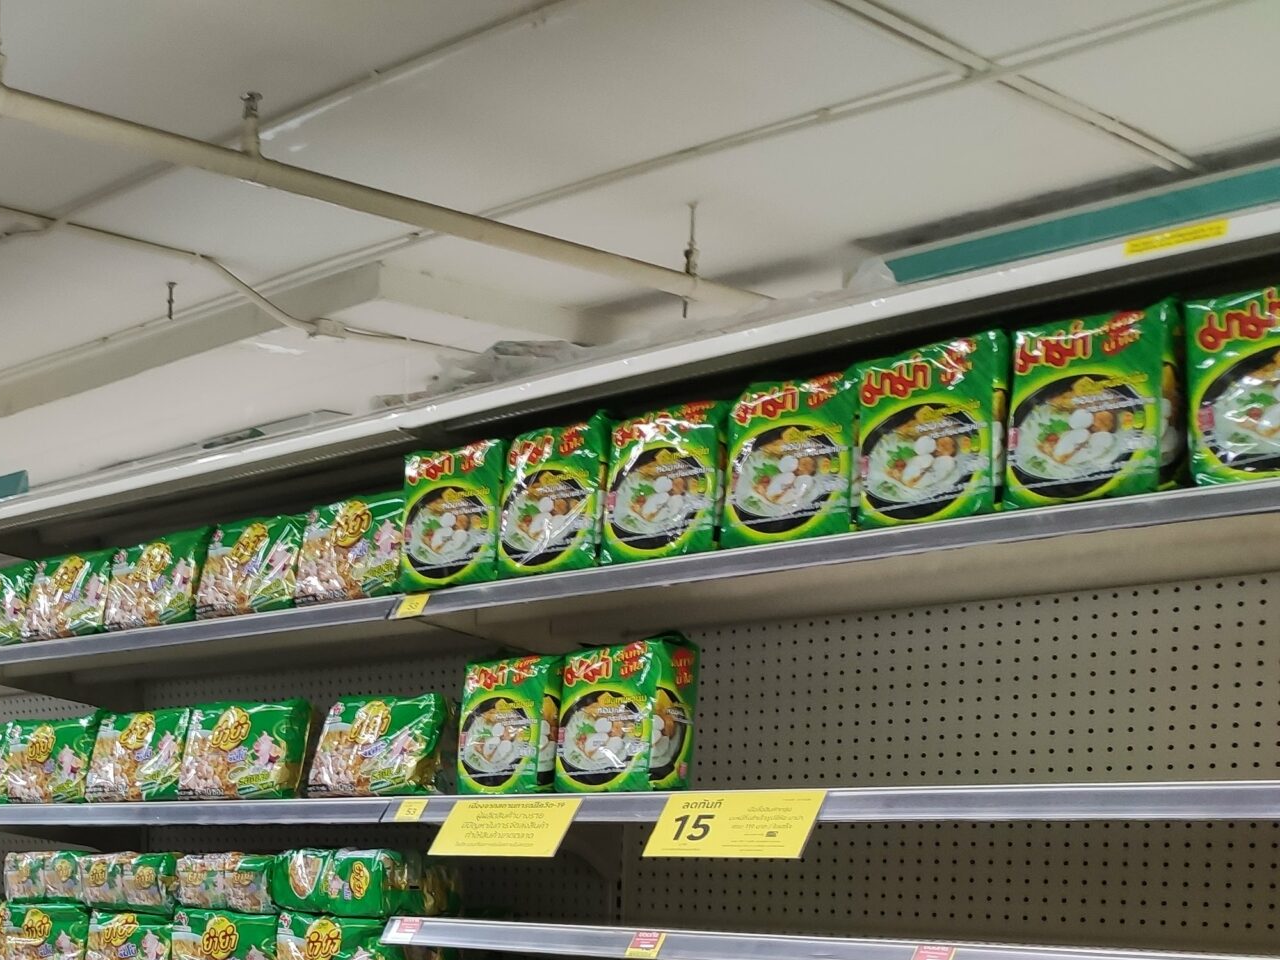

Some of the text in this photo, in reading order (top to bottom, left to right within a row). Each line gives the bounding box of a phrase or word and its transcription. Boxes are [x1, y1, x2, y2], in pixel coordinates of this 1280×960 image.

[859, 352, 932, 407] มาม่า
[682, 798, 725, 810] ลดทันที
[673, 814, 715, 841] 15
[202, 923, 240, 956] ยำยำ
